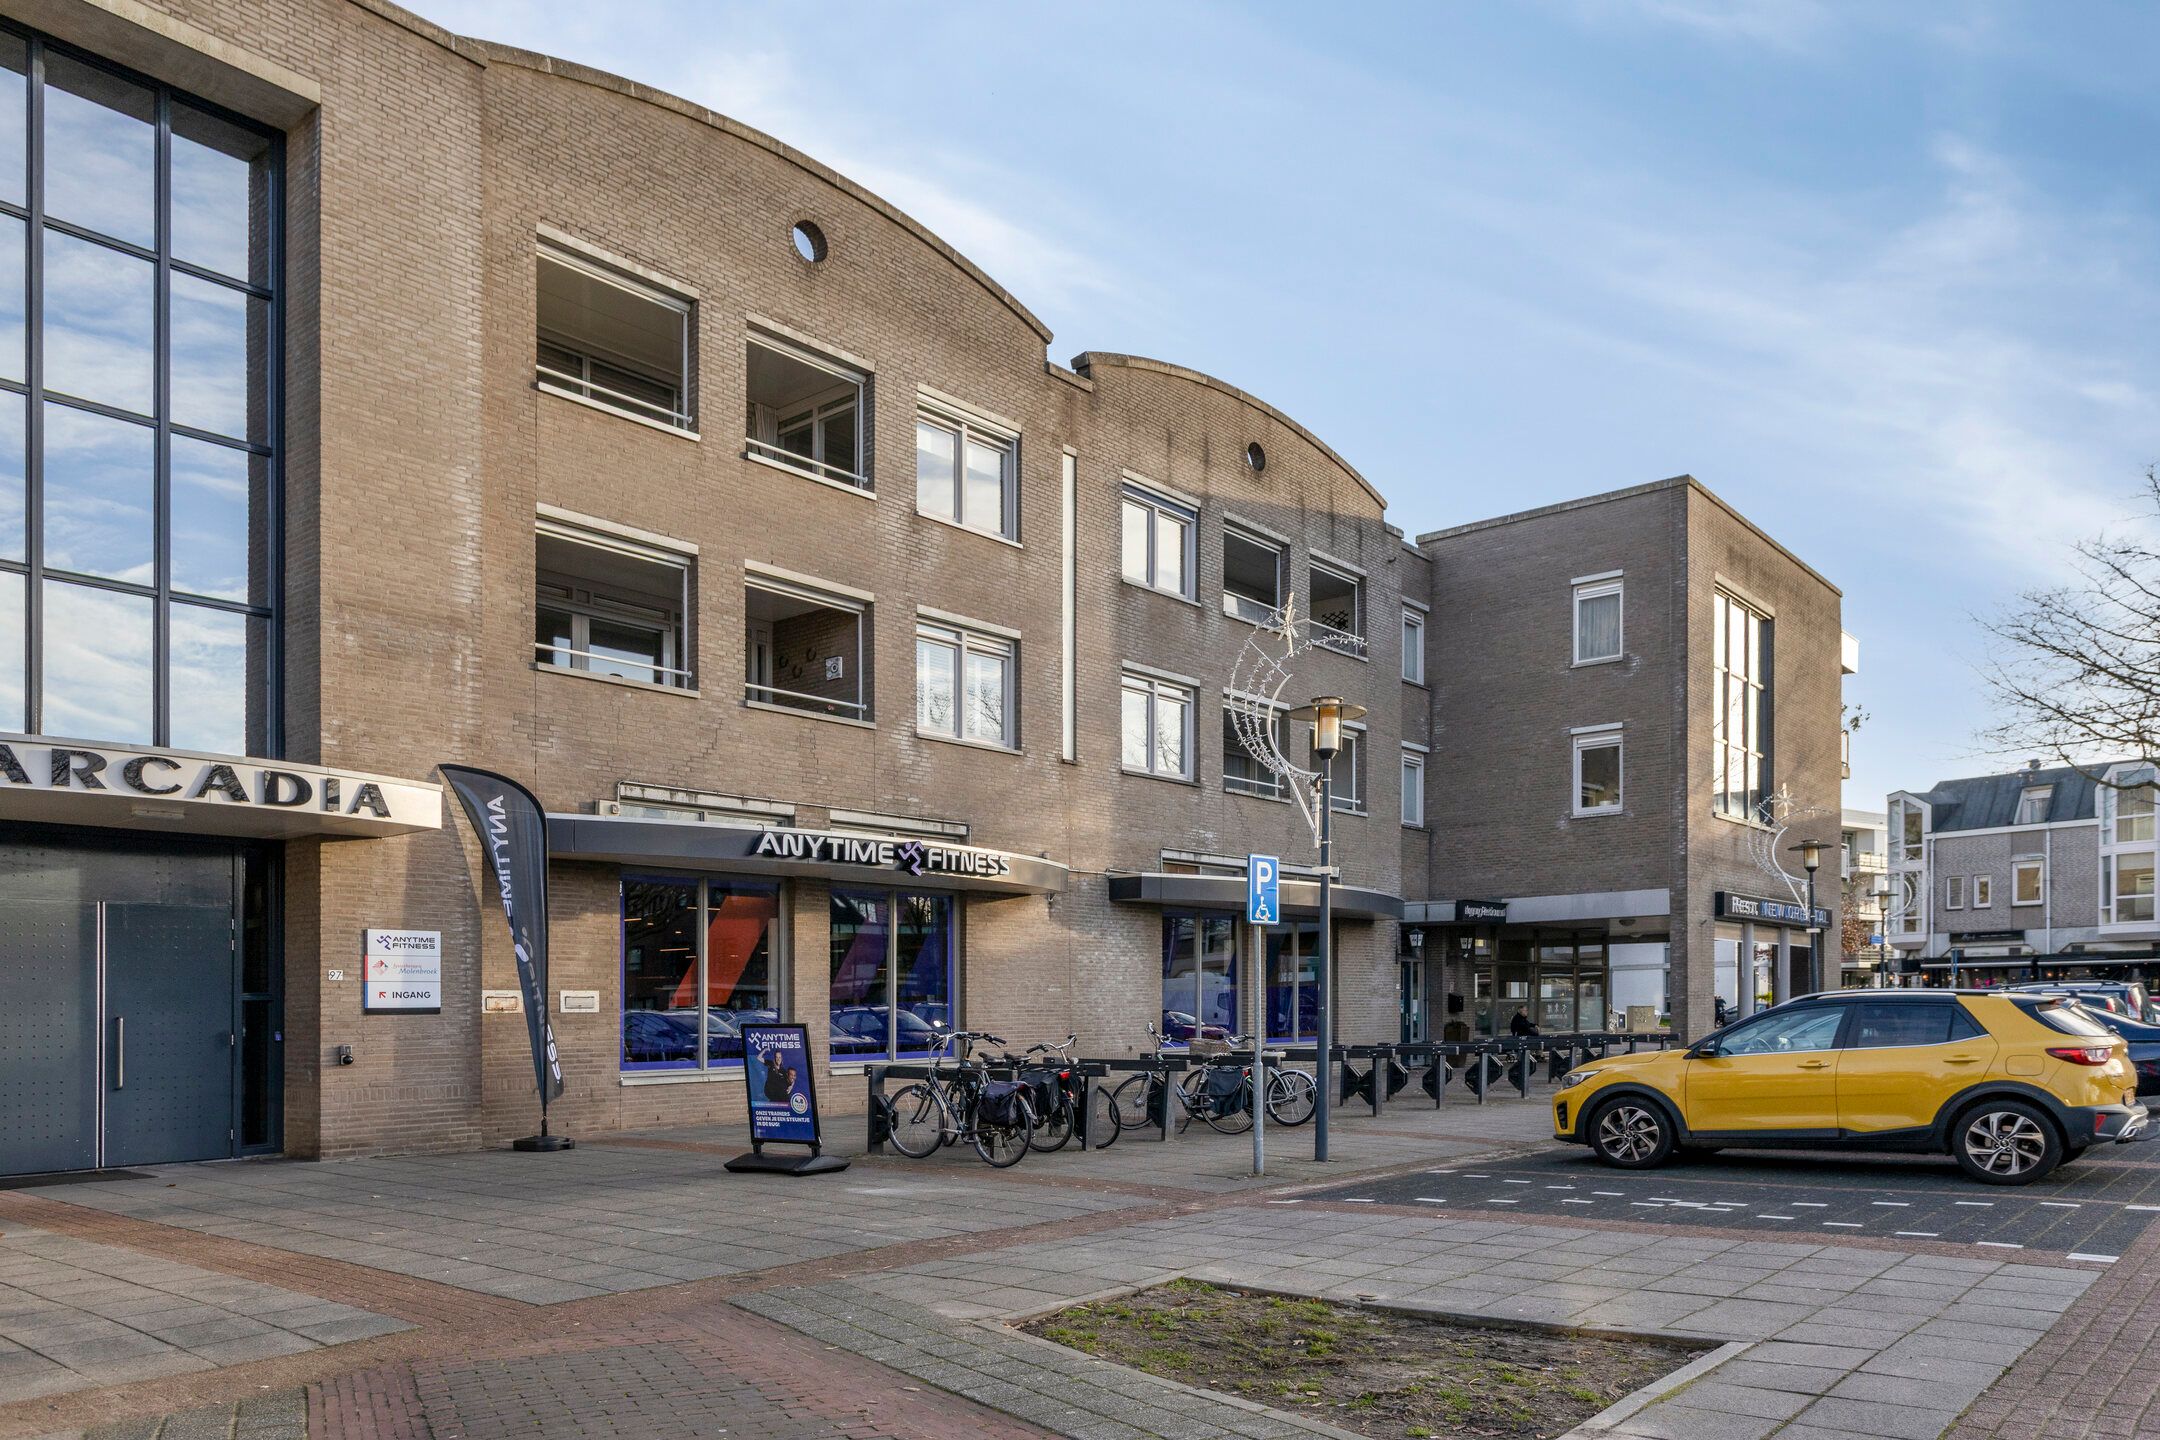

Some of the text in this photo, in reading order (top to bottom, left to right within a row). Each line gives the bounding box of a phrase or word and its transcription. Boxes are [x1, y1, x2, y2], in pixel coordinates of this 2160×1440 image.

[756, 832, 1011, 876] ANYTIME FITNESS
[1256, 861, 1273, 895] P
[329, 970, 342, 980] 97
[398, 967, 438, 975] Molenbroek
[392, 991, 431, 999] INGANG
[761, 1033, 800, 1041] ANYTIME
[761, 1041, 802, 1049] FITNESS
